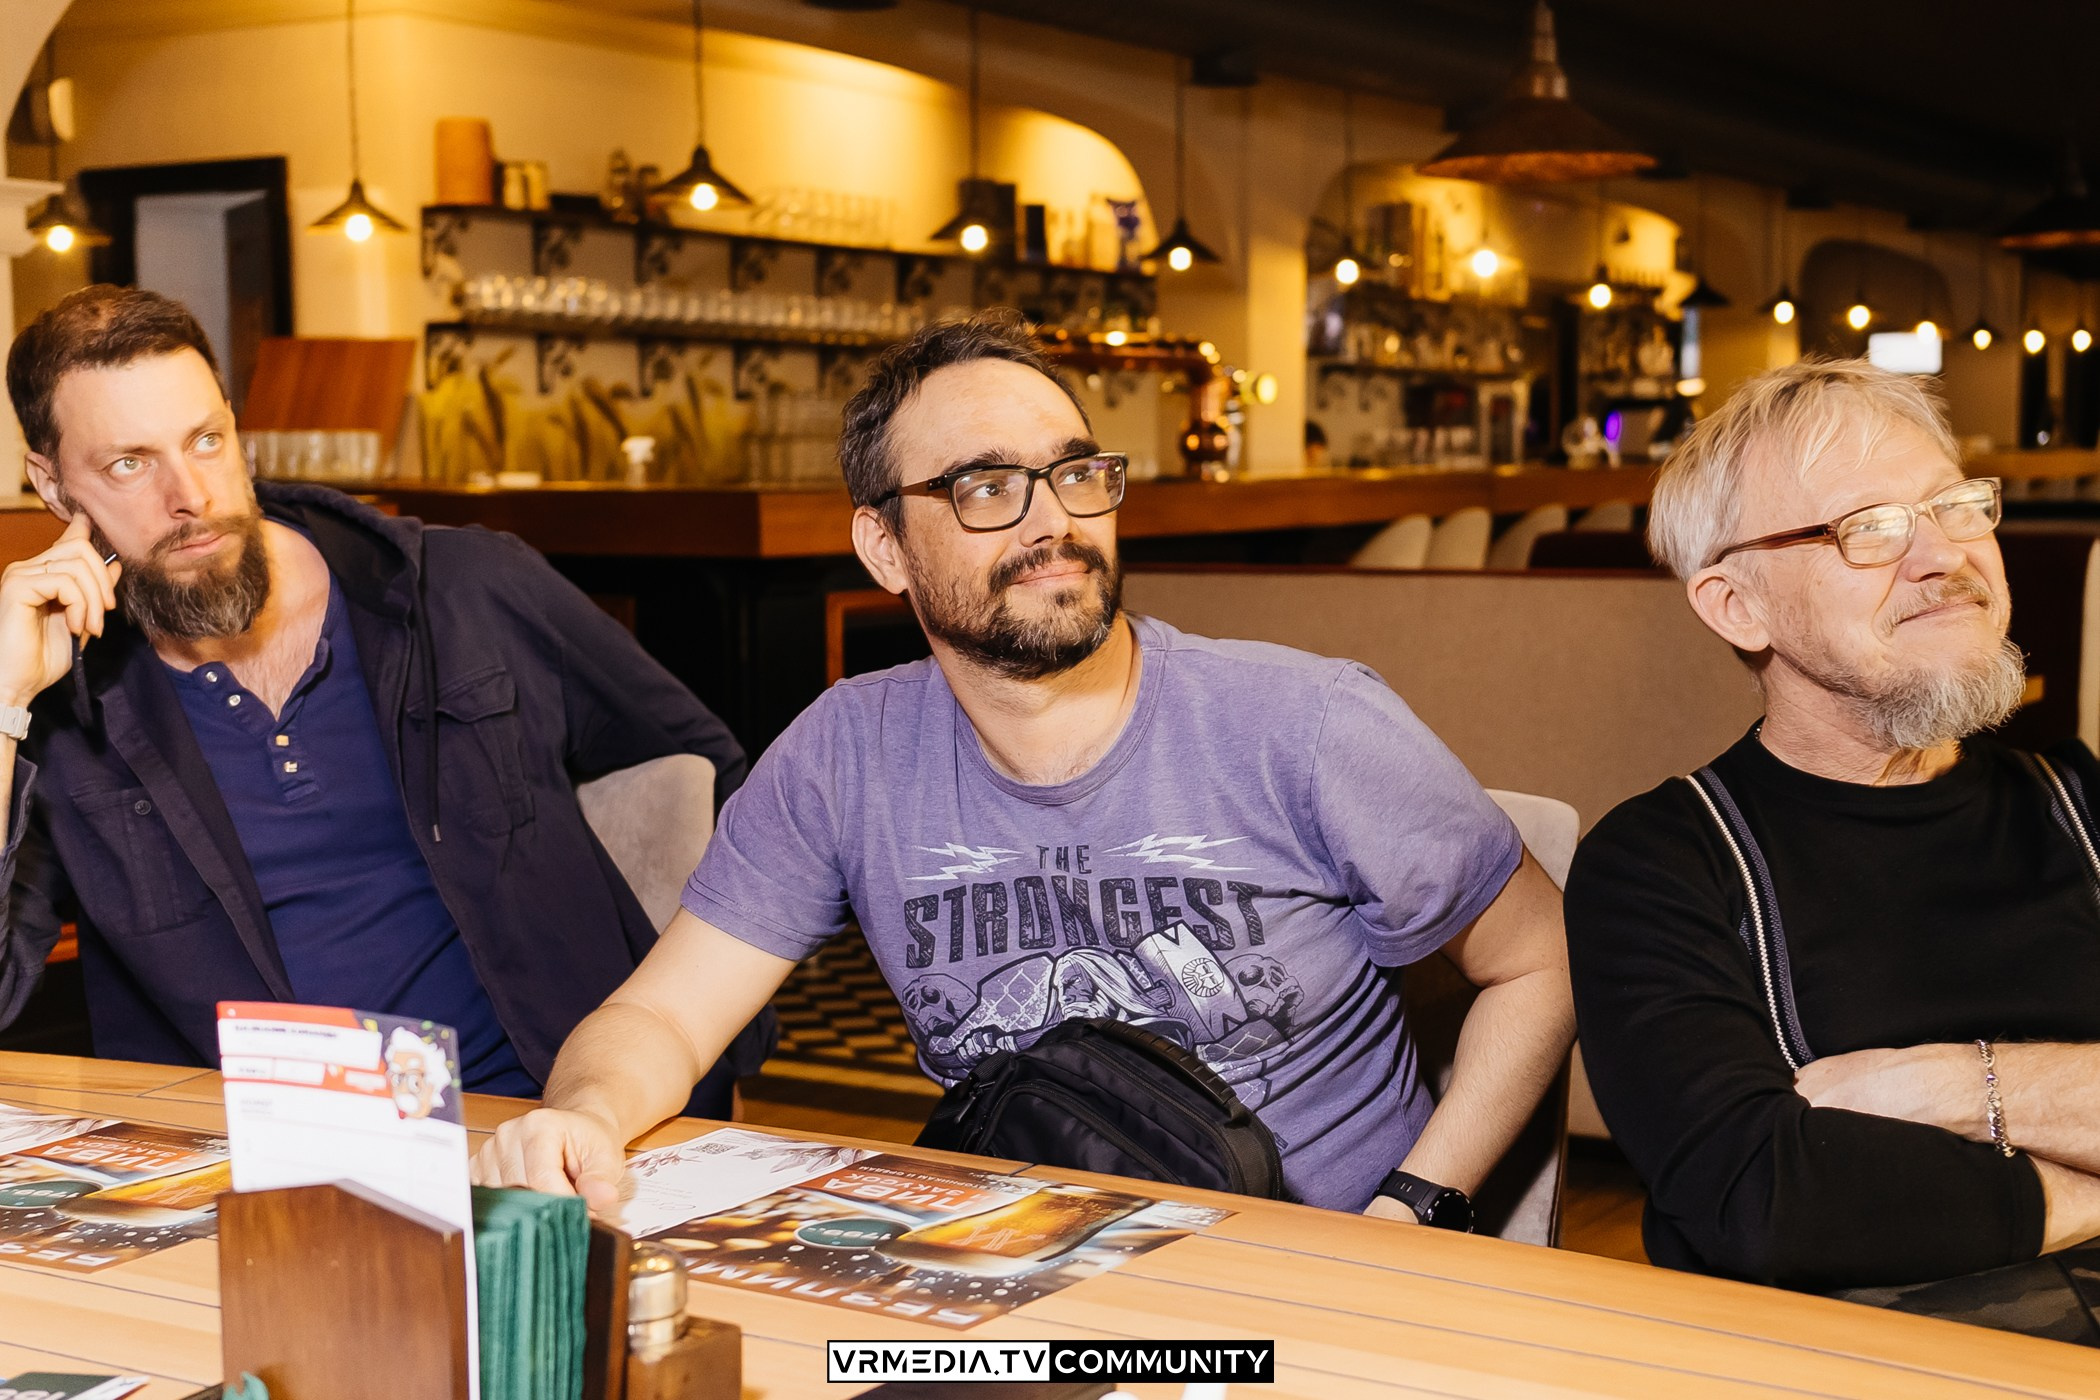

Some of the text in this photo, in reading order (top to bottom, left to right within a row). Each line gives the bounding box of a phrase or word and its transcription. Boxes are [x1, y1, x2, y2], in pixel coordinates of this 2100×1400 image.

[1036, 844, 1092, 875] THE
[905, 875, 1264, 969] STRONGEST
[43, 1145, 179, 1171] ПИВА
[823, 1177, 977, 1212] ПИВА
[845, 1173, 965, 1196] ЗАКУСОК
[684, 1257, 983, 1326] БЕЗЛИМ
